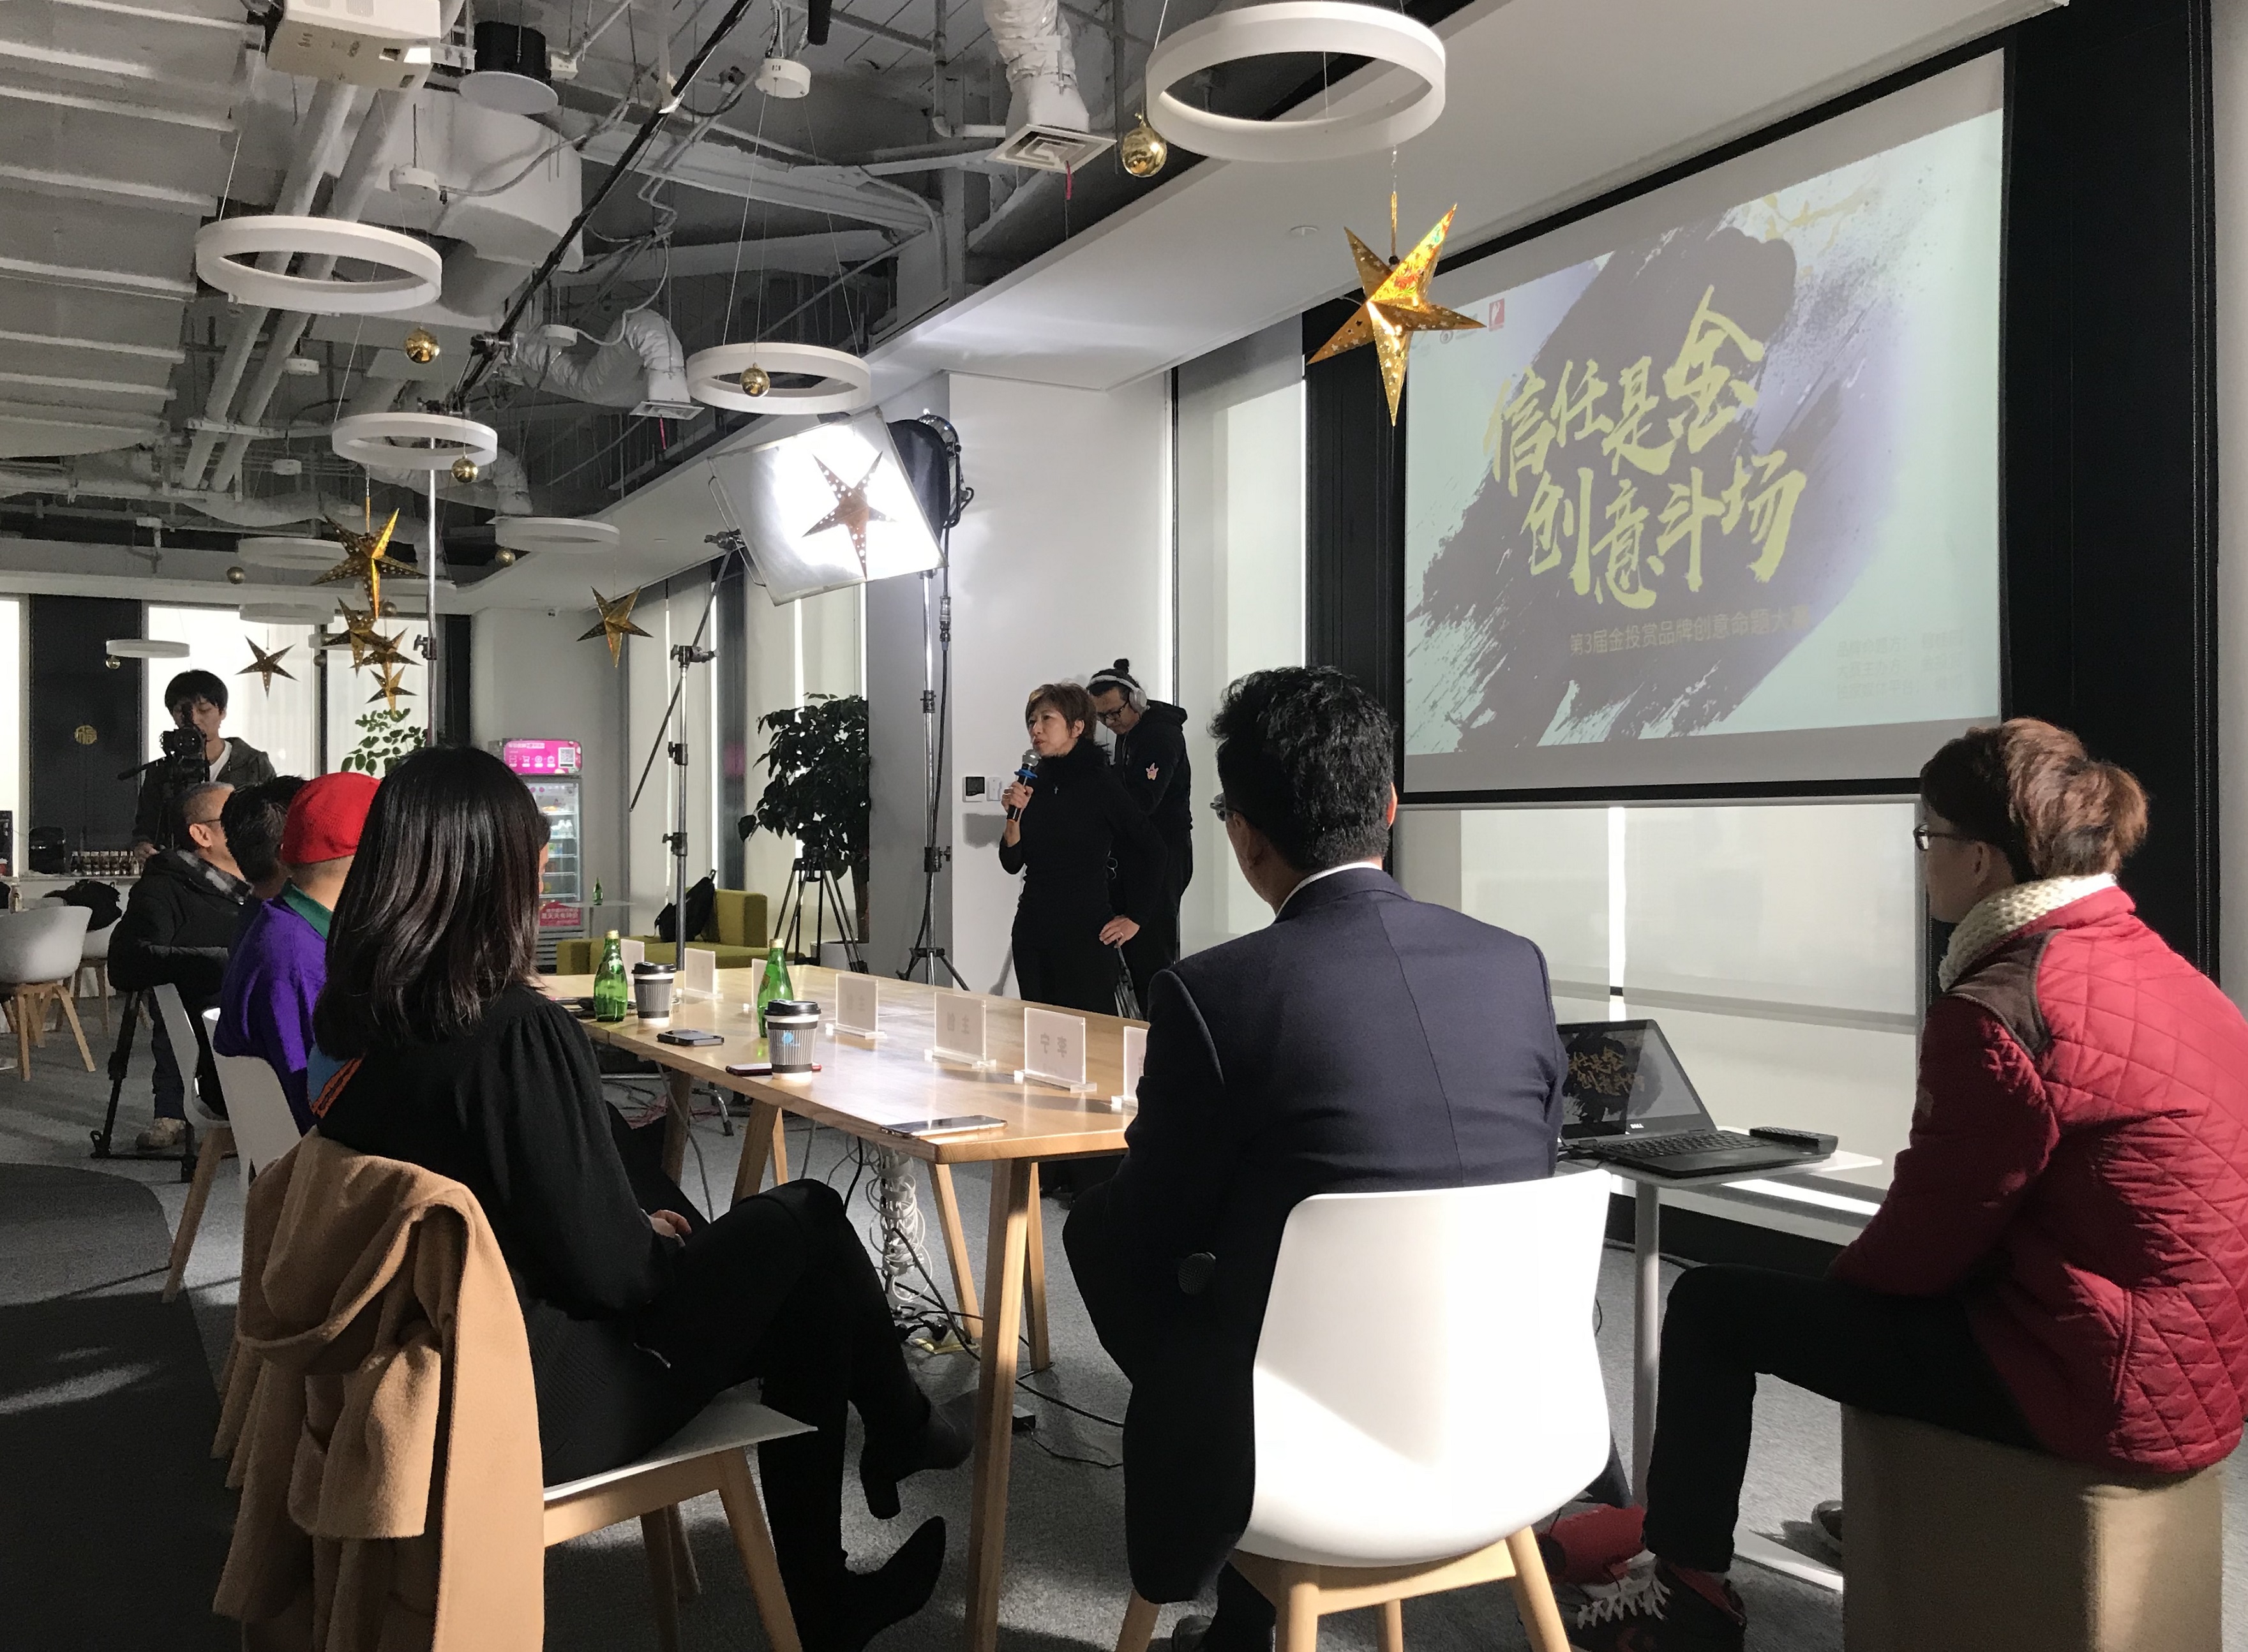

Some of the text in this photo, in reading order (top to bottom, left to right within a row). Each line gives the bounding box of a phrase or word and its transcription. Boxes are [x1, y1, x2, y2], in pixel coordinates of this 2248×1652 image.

[1482, 284, 1765, 498] 信任是金
[1520, 450, 1808, 609] 创意斗场
